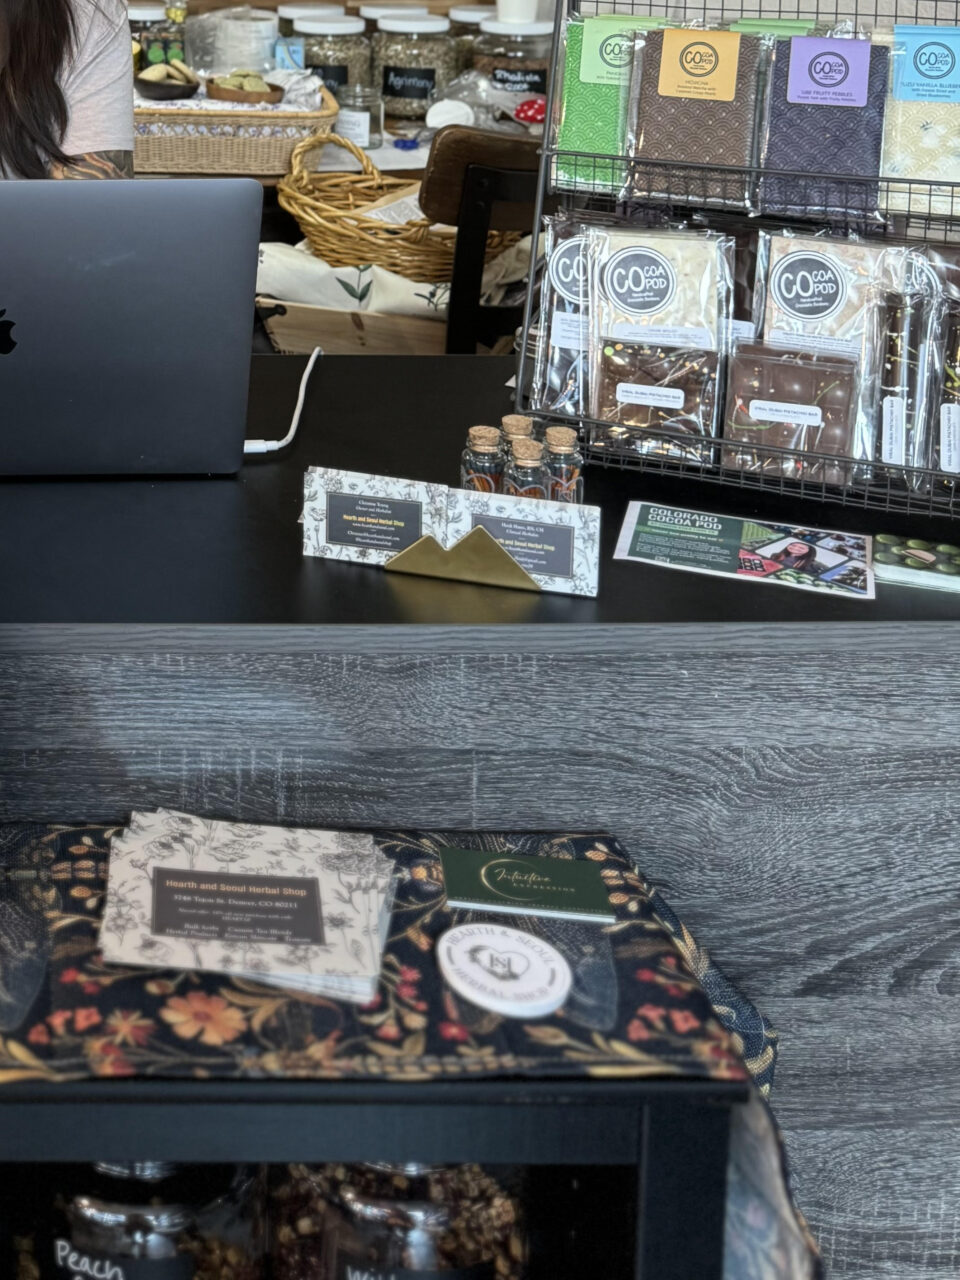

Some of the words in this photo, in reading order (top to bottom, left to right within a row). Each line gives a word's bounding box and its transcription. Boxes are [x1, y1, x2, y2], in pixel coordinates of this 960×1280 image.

[388, 71, 433, 91] Agrimony
[645, 277, 667, 289] POD
[814, 282, 837, 294] POD
[393, 519, 405, 527] Shop
[648, 514, 692, 527] COCOA
[695, 520, 723, 530] POD
[649, 507, 718, 524] COLORADO
[543, 543, 555, 551] Shop
[165, 879, 197, 889] Hearth
[199, 881, 217, 890] and
[220, 883, 246, 893] Seoul
[249, 884, 280, 895] Herbal
[283, 887, 307, 898] Shop
[228, 898, 257, 907] Denver,
[444, 926, 493, 946] HEARTH
[513, 934, 553, 964] SEOUL
[54, 1238, 123, 1280] Peach
